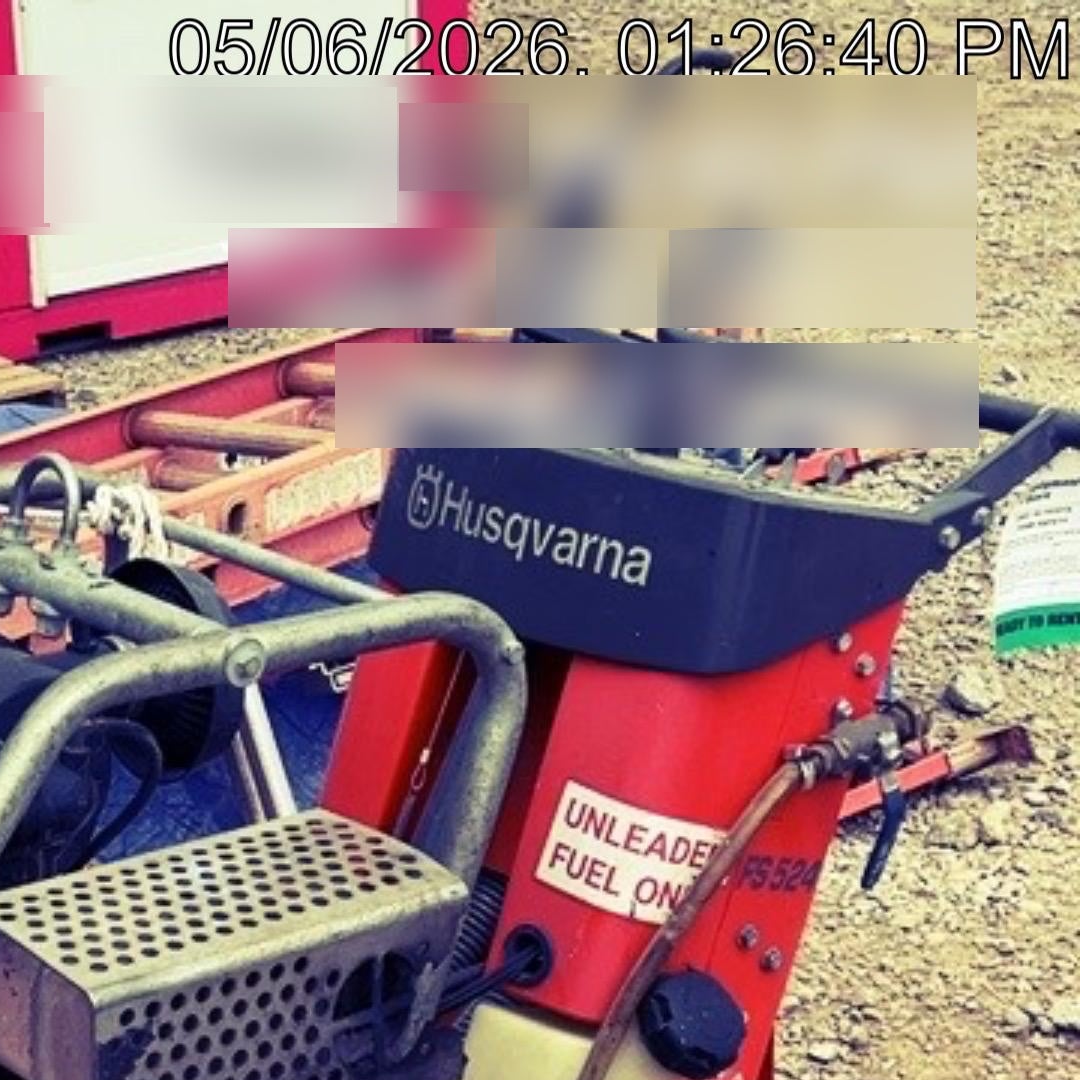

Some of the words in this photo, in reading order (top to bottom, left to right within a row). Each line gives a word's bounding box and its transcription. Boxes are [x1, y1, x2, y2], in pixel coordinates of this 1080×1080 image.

[437, 480, 653, 587] Husqvarna
[548, 841, 620, 897] FUEL
[634, 876, 698, 914] ON
